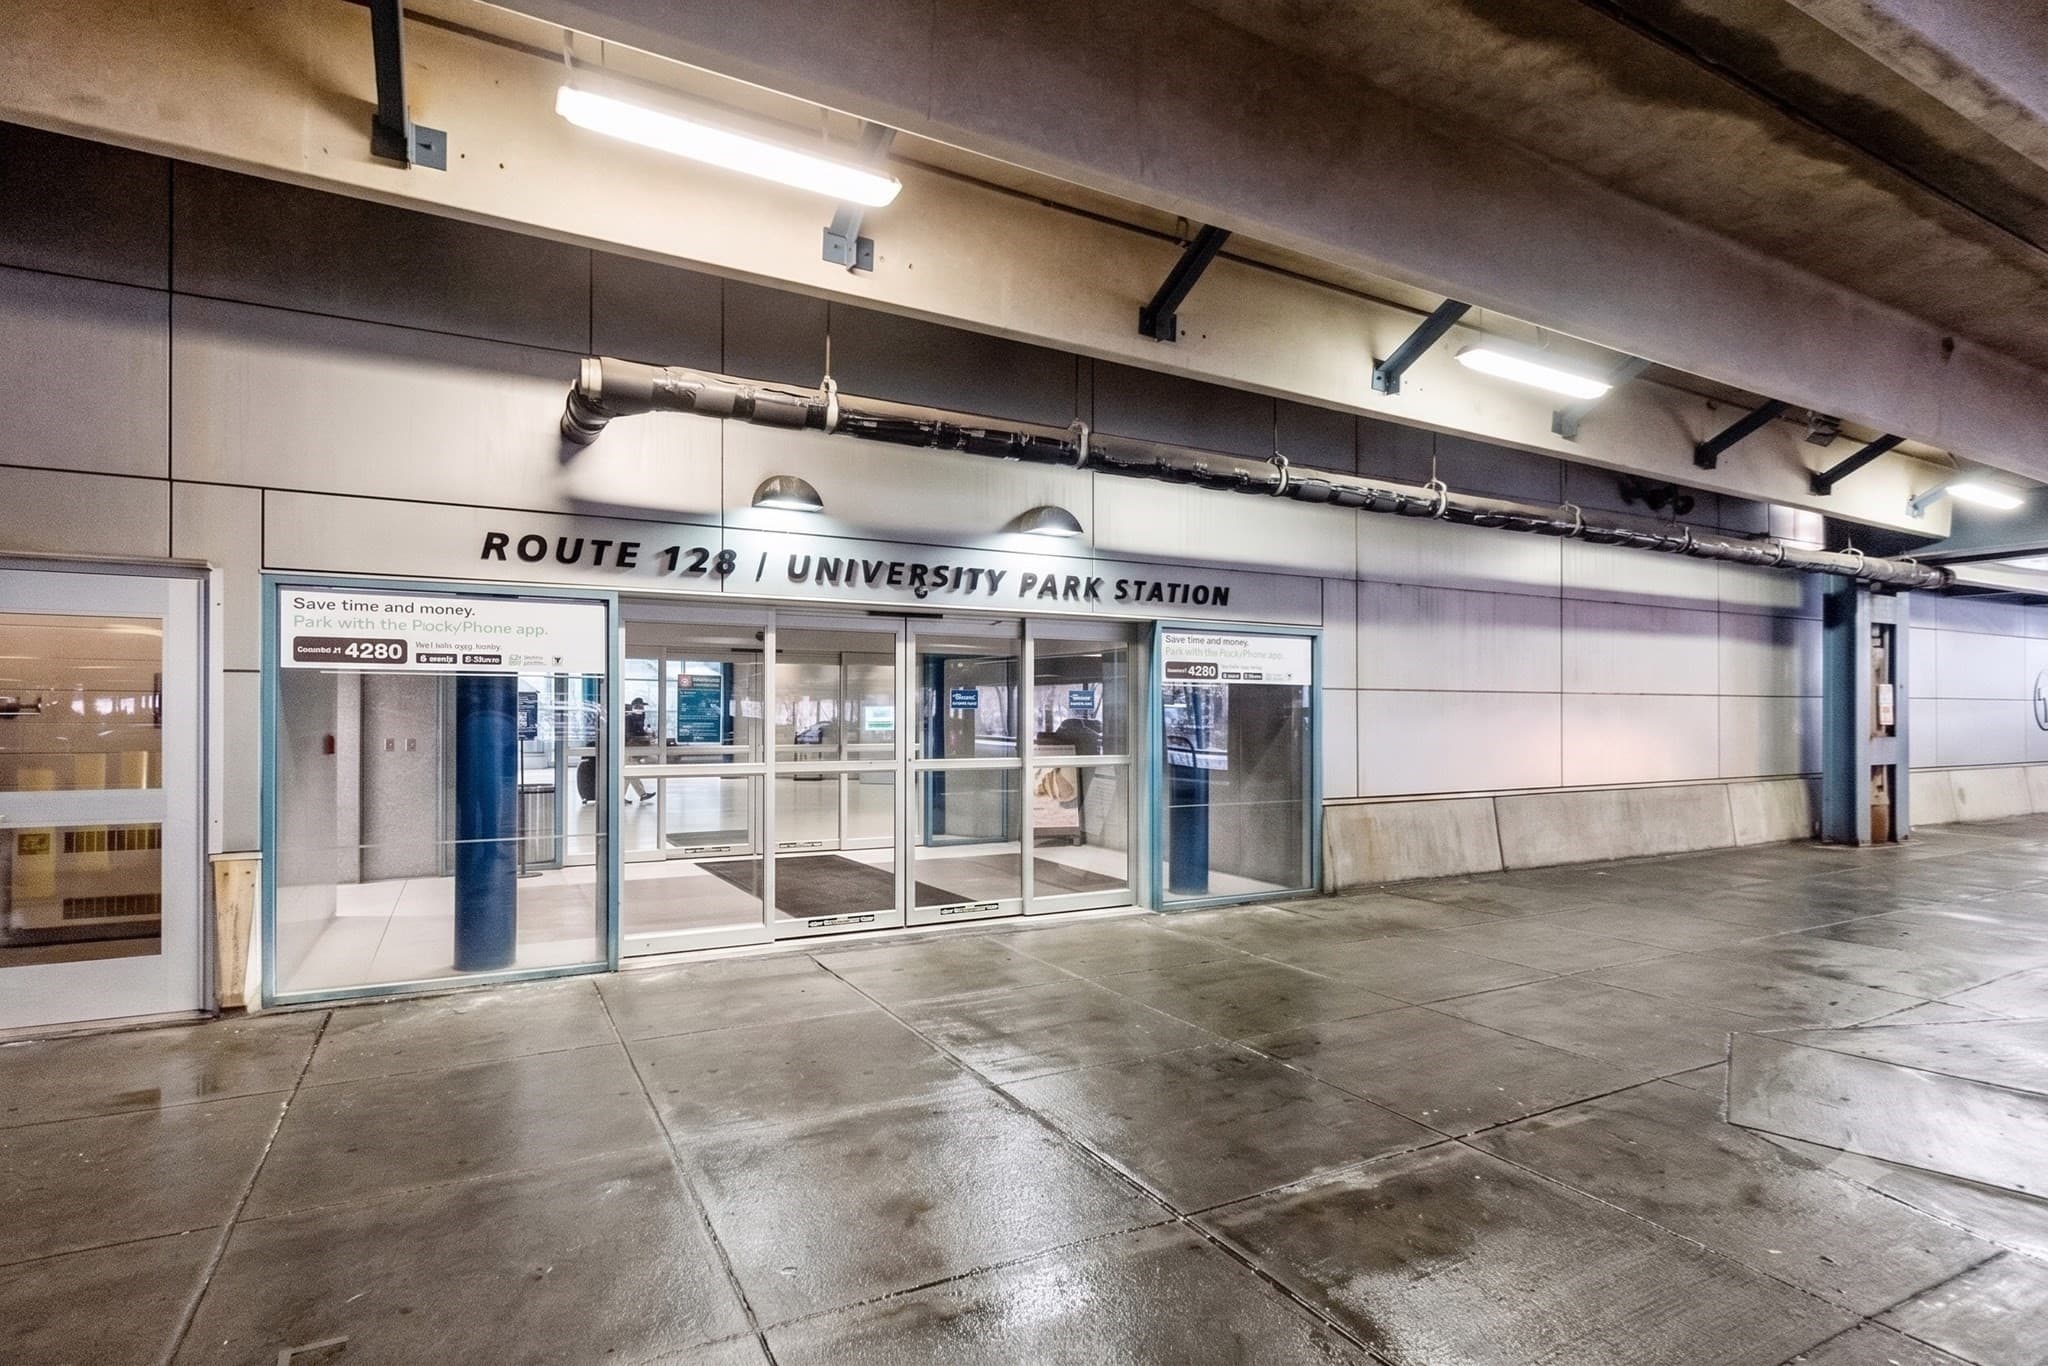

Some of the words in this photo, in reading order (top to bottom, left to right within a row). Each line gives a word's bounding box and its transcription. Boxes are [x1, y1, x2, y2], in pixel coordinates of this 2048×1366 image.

[480, 531, 641, 568] ROUTE
[664, 546, 738, 575] 128
[787, 554, 1006, 597] UNIVERSITY
[1018, 572, 1104, 601] PARK
[1114, 578, 1230, 606] STATION
[293, 597, 336, 612] Save
[341, 599, 379, 613] time
[384, 602, 415, 615] and
[419, 605, 476, 618] money.
[293, 616, 333, 629] Park
[338, 617, 375, 631] with
[380, 619, 408, 632] the
[516, 626, 549, 638] app.
[344, 643, 403, 660] 4280
[1188, 666, 1216, 677] 4280
